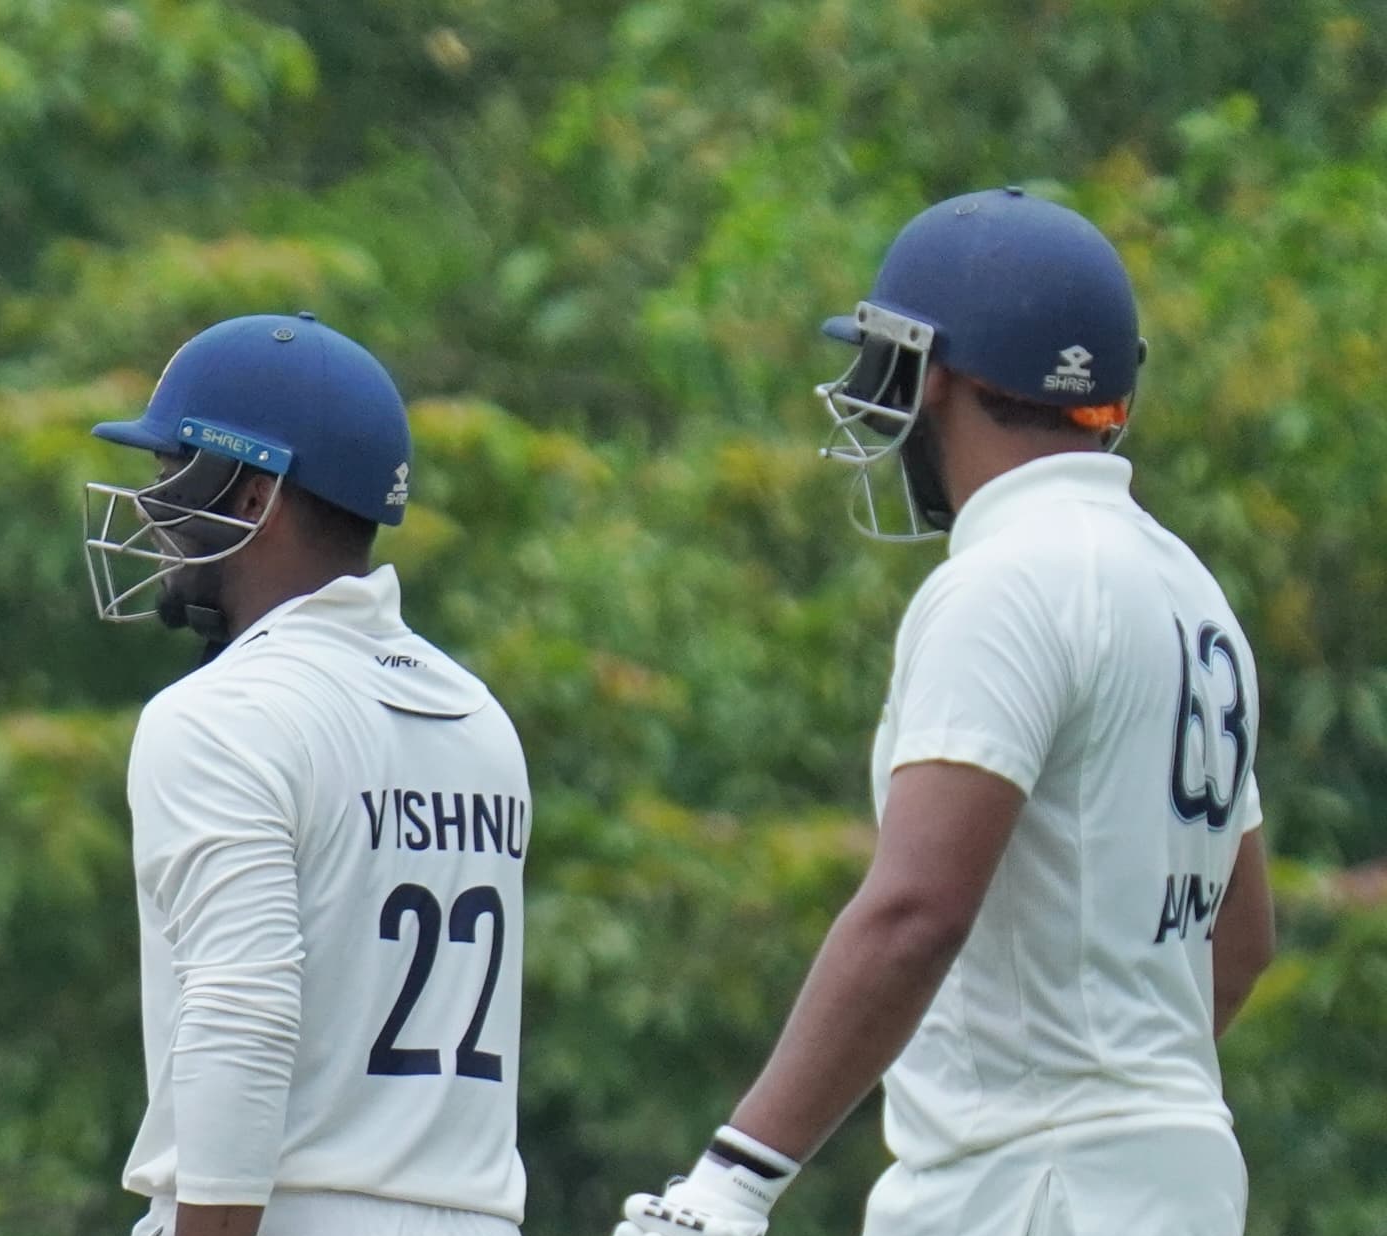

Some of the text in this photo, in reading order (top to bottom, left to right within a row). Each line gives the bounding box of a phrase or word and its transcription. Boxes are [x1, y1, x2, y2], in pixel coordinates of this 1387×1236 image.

[1043, 374, 1096, 394] SHREY
[201, 427, 255, 455] SHREY
[1169, 612, 1249, 832] 63
[360, 788, 525, 860] VISHNU
[366, 882, 505, 1083] 22
